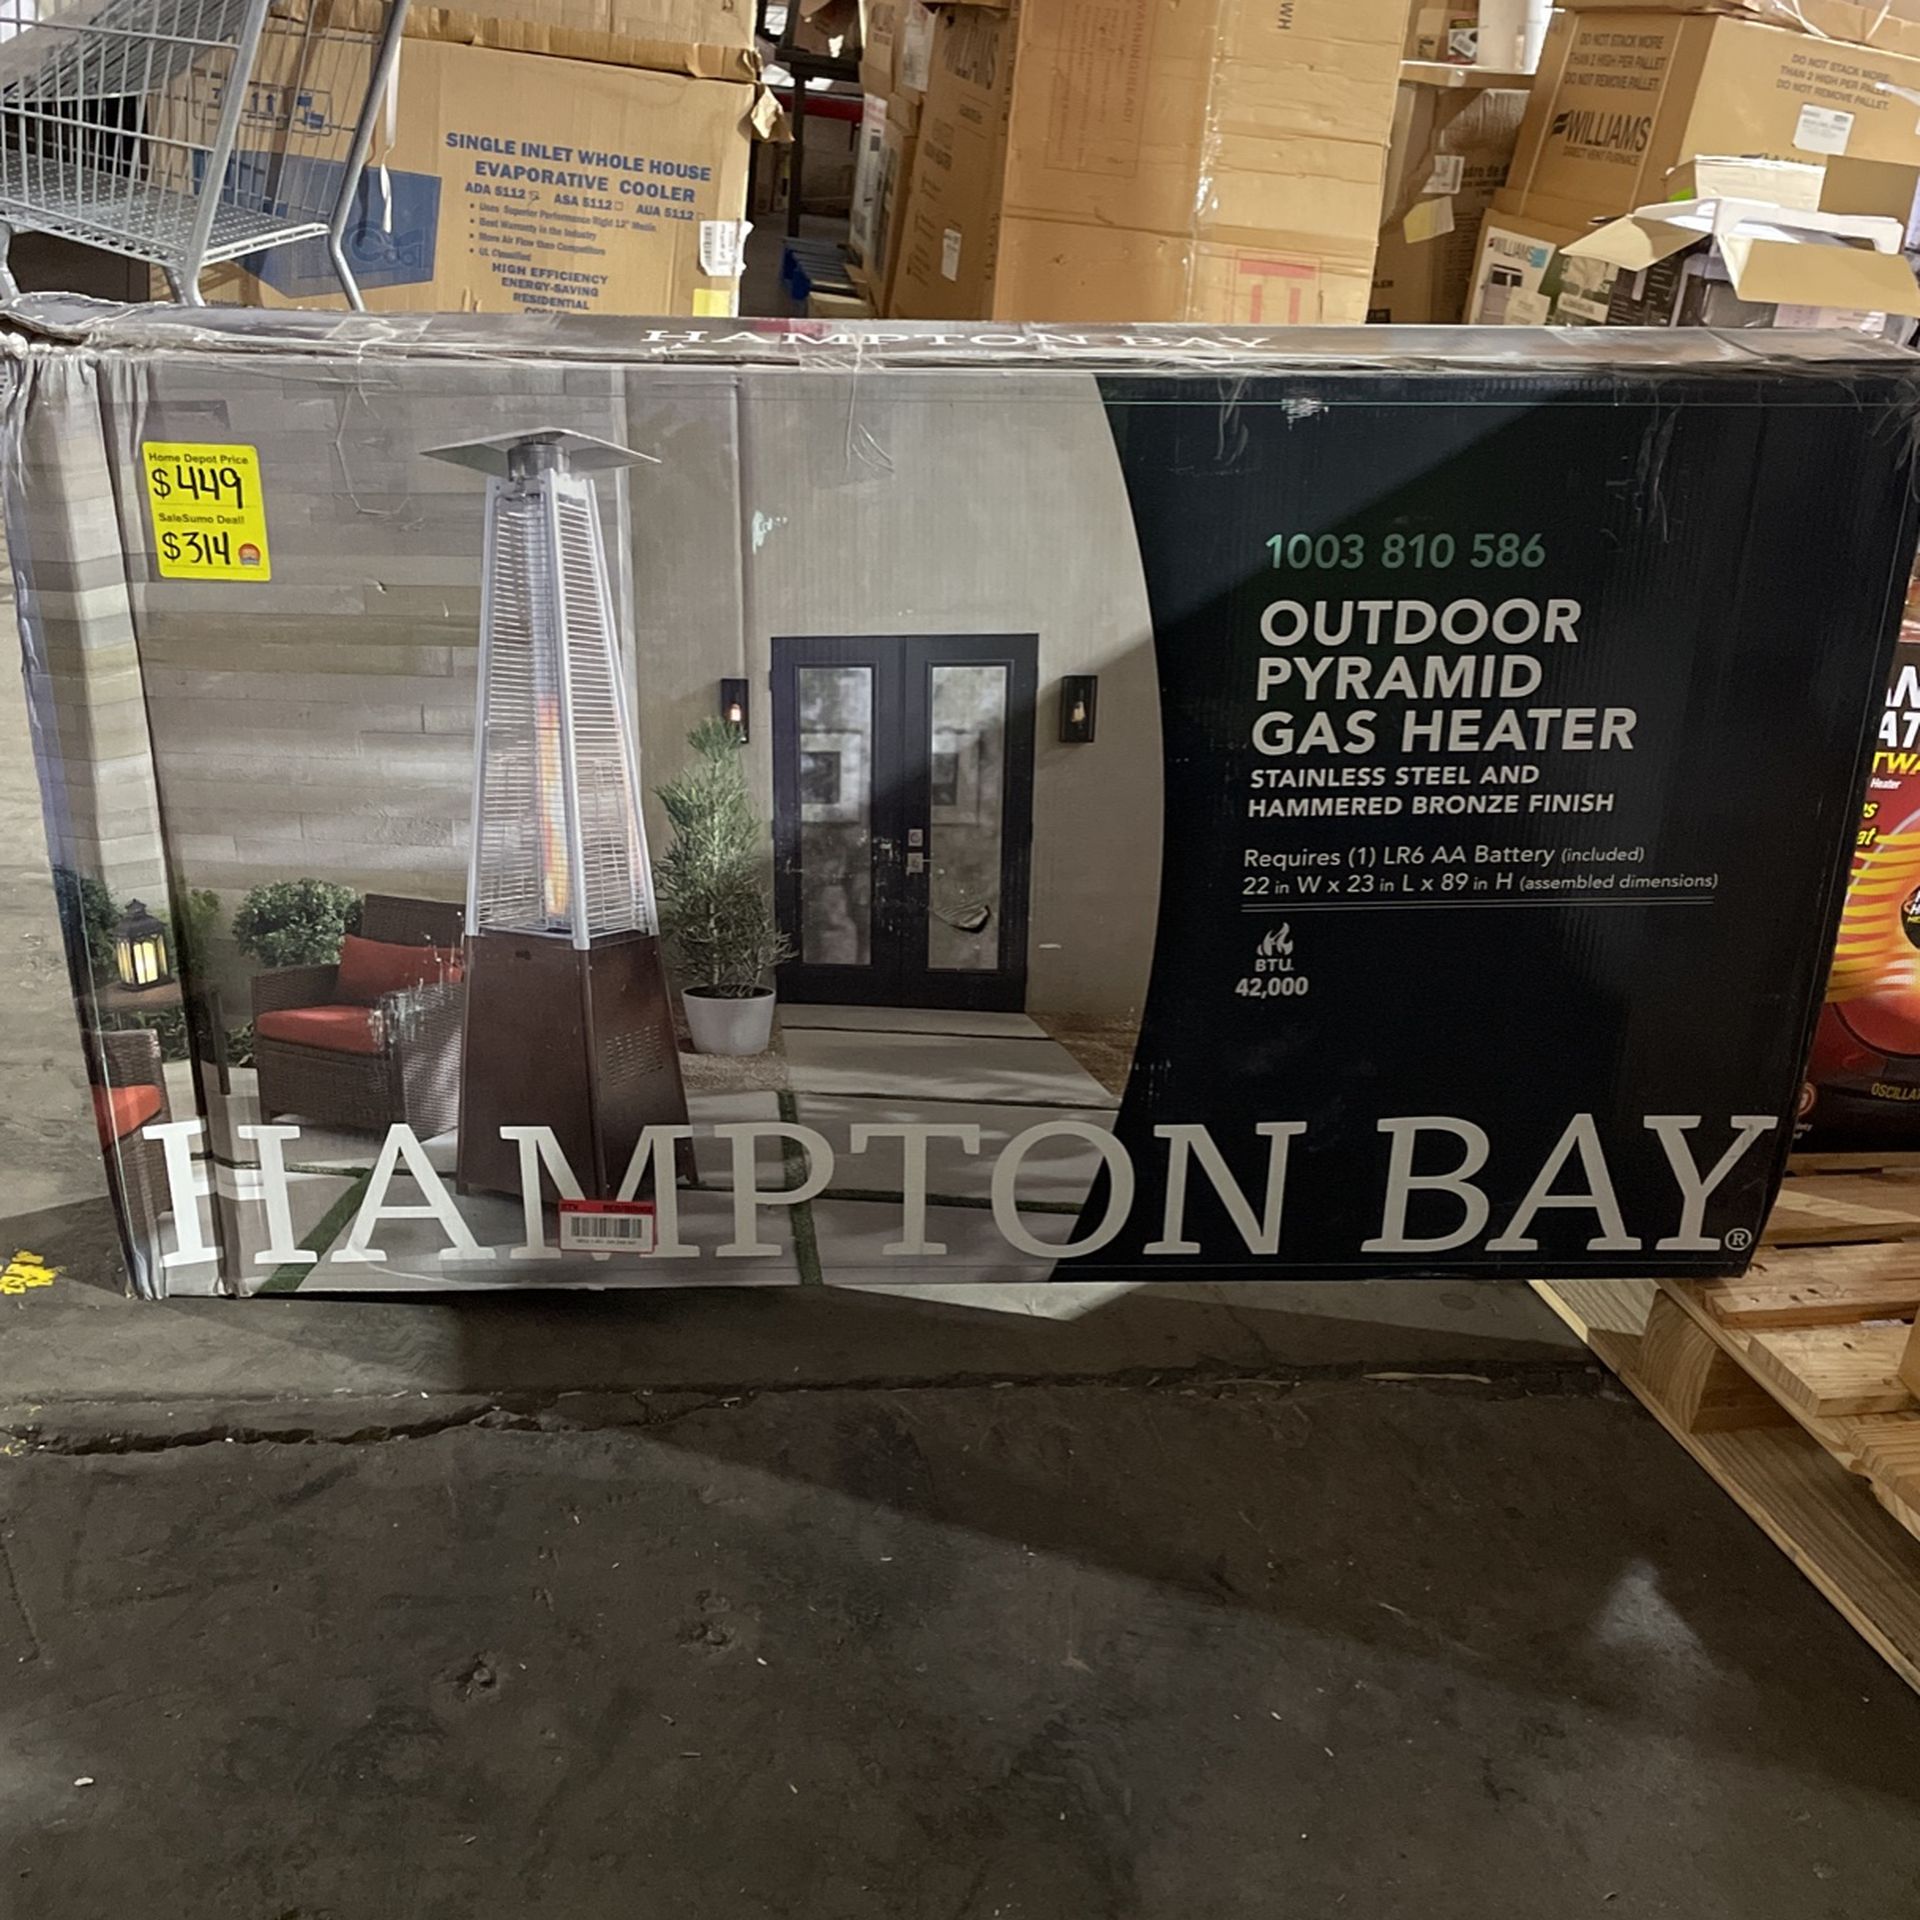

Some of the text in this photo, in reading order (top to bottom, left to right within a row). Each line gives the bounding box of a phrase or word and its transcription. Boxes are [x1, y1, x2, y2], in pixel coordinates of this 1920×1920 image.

[1808, 57, 1829, 69] NOT
[1830, 61, 1859, 76] STACK
[1566, 109, 1652, 153] WILLIAMS
[446, 132, 712, 182] SINGLE INLET WHOLE HOUSE
[475, 160, 695, 203] EVAPORATIVE COOLER
[465, 182, 694, 221] ADA 5112 ASA 5112 AUA 5112
[492, 262, 608, 285] HIGH EFFICIENCY
[501, 277, 599, 297] ENERGY-SAVING
[513, 292, 590, 310] RESIDENTIAL
[641, 330, 1271, 349] HAMPTON BAY
[148, 453, 249, 465] Home Depot Price
[158, 512, 214, 524] SaleSumo
[162, 531, 231, 566] $314
[1265, 533, 1546, 569] 1003 810 586
[1260, 598, 1582, 646] OUTDOOR
[1256, 655, 1543, 701] PYRAMID
[1251, 708, 1638, 756] GAS HEATER
[1250, 765, 1540, 789] STAINLESS STEEL AND
[1247, 793, 1615, 818] HAMMERED BRONZE FINISH
[1244, 845, 1645, 871] Requires (1) LR6 AA Battery (included)
[1242, 872, 1719, 895] 22 in W x 23 in L x 89 in H (assembled dimensions)
[1234, 976, 1309, 1000] 42,000
[142, 1118, 1308, 1264] HAMPTON
